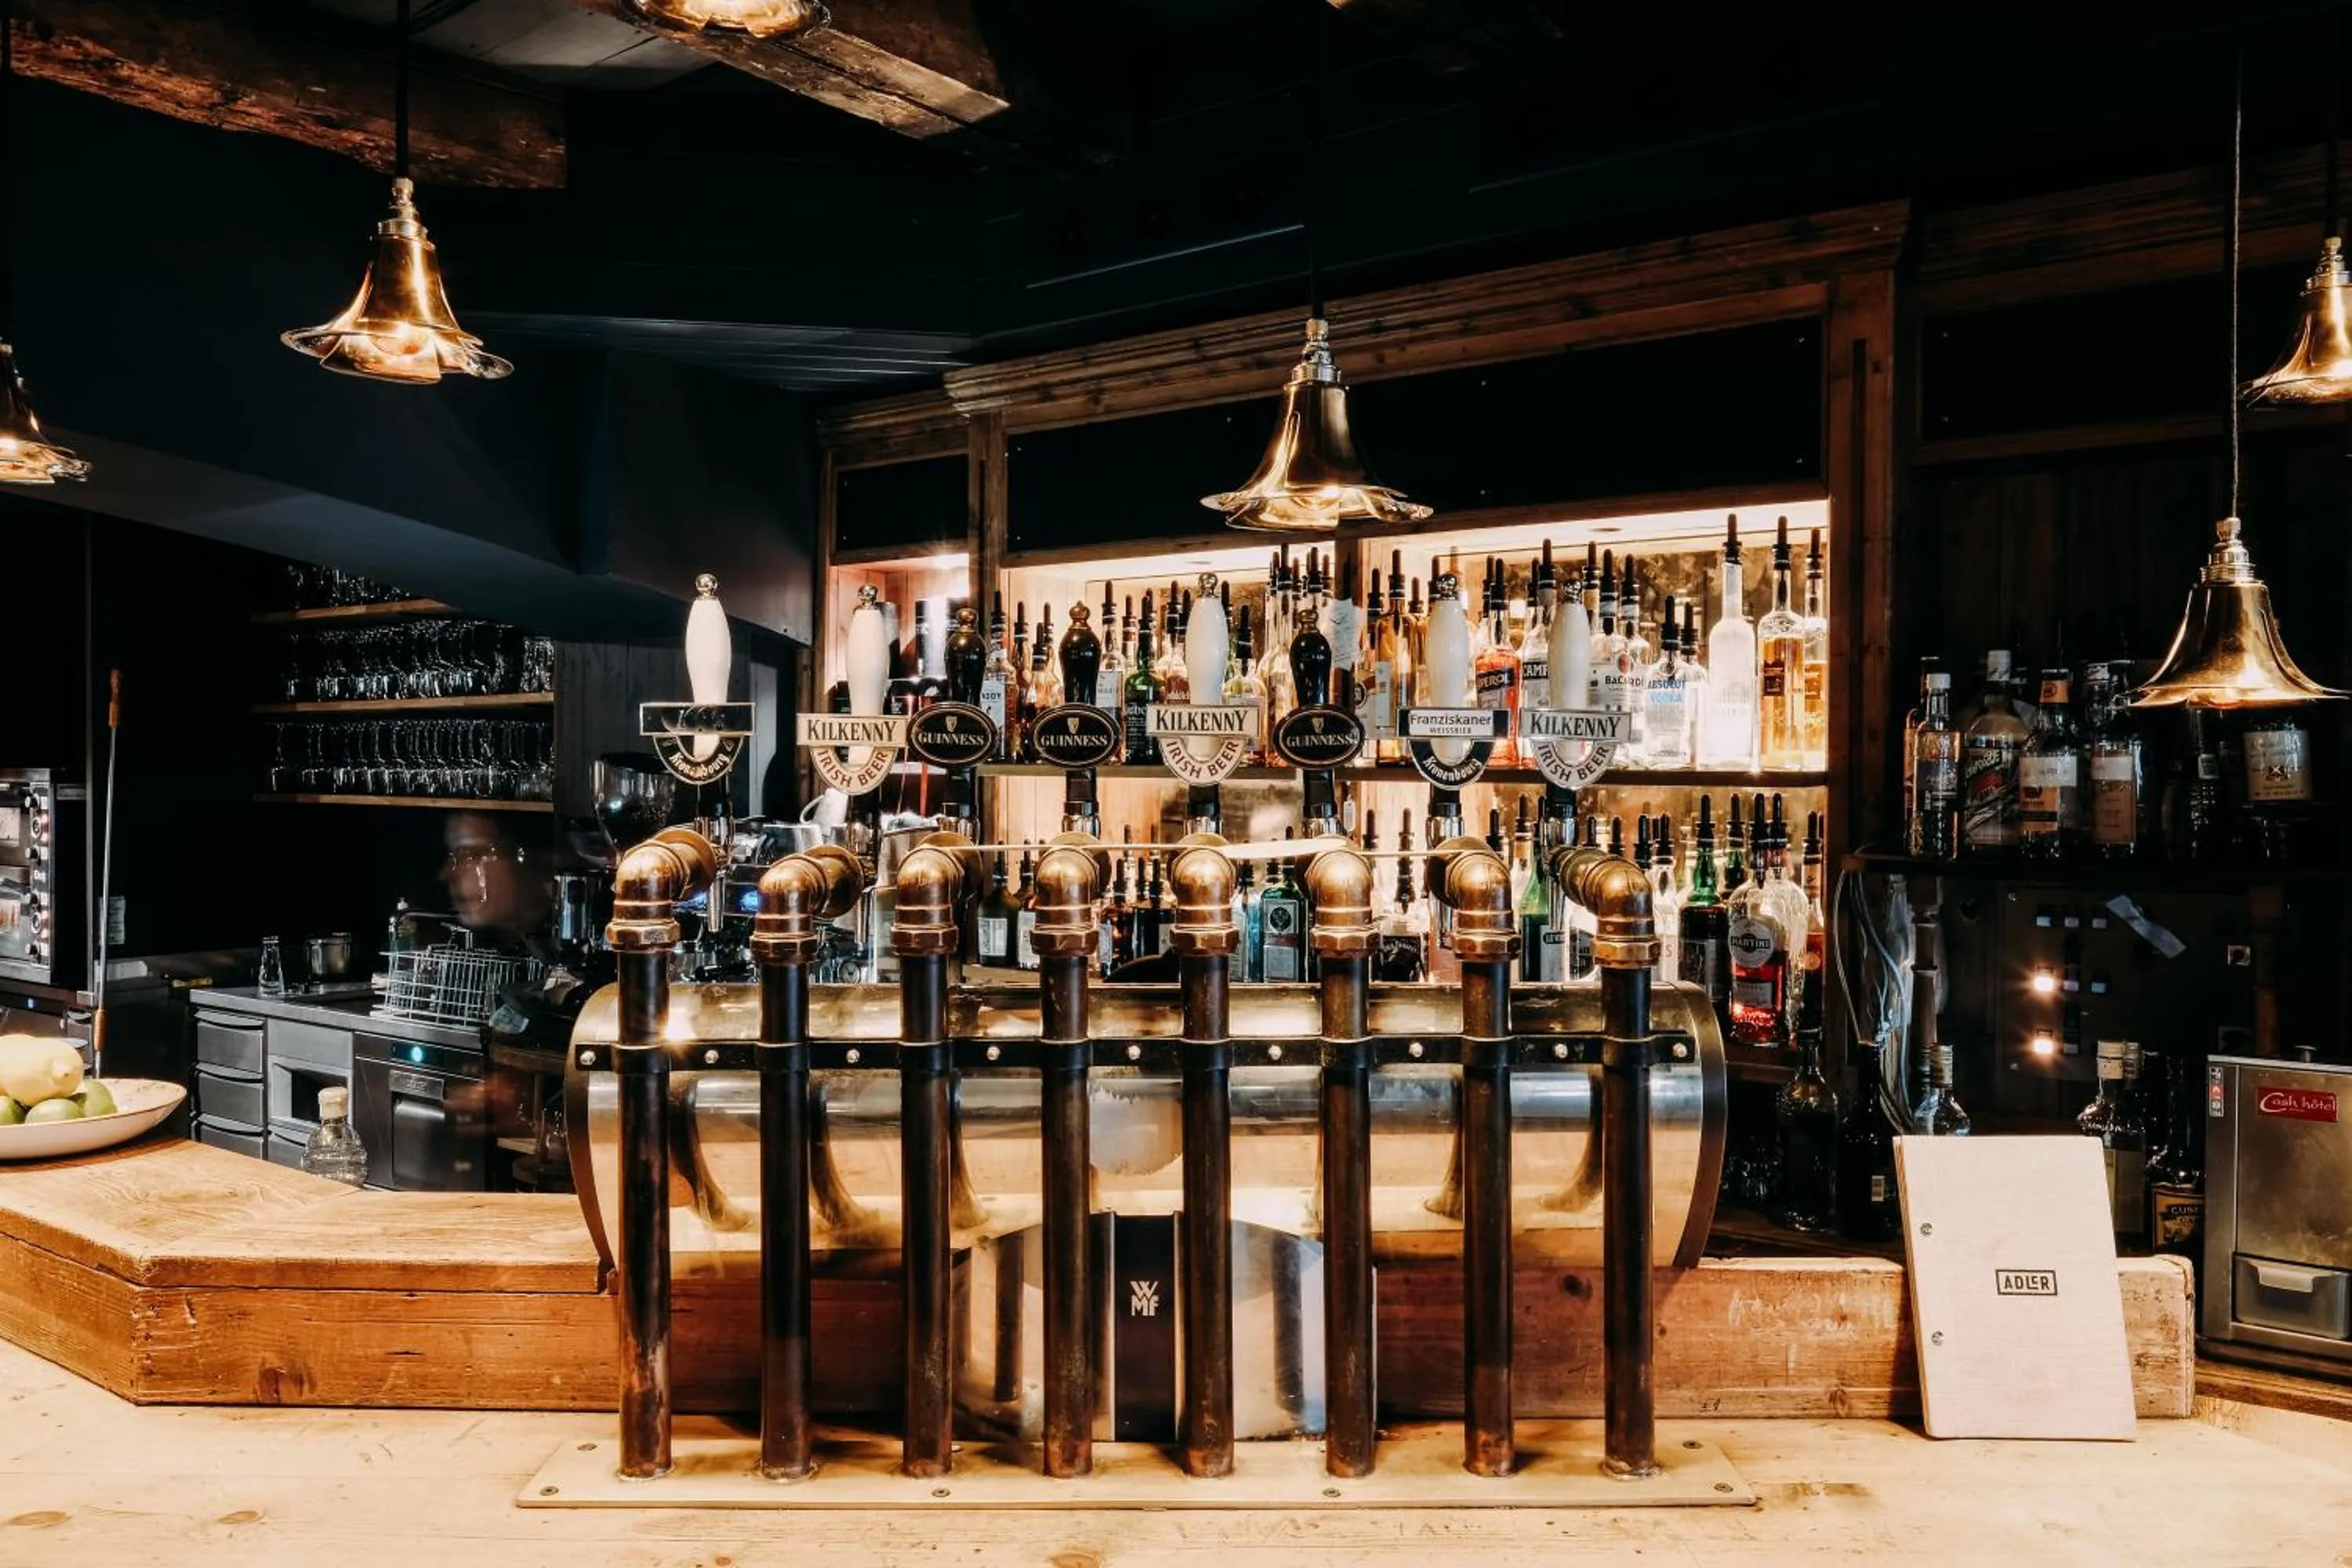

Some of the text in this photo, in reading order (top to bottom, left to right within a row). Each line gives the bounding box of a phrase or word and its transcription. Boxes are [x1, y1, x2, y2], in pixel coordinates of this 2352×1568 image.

[1647, 679, 1686, 689] ABSOLUT
[807, 719, 898, 742] KILKENNY
[1156, 709, 1249, 731] KILKENNY
[1410, 714, 1492, 725] Franziskaner
[1530, 713, 1622, 738] KILKENNY
[918, 731, 985, 746] GUINNESS
[1040, 735, 1108, 746] GUINNESS
[1287, 734, 1352, 747] GUINNESS
[817, 750, 888, 788] IRISH BEER
[1166, 741, 1240, 779] IRISH BEER
[1537, 744, 1610, 782] IRISH BEER
[2005, 1275, 2050, 1290] ADLER
[1130, 1280, 1160, 1316] WMF
